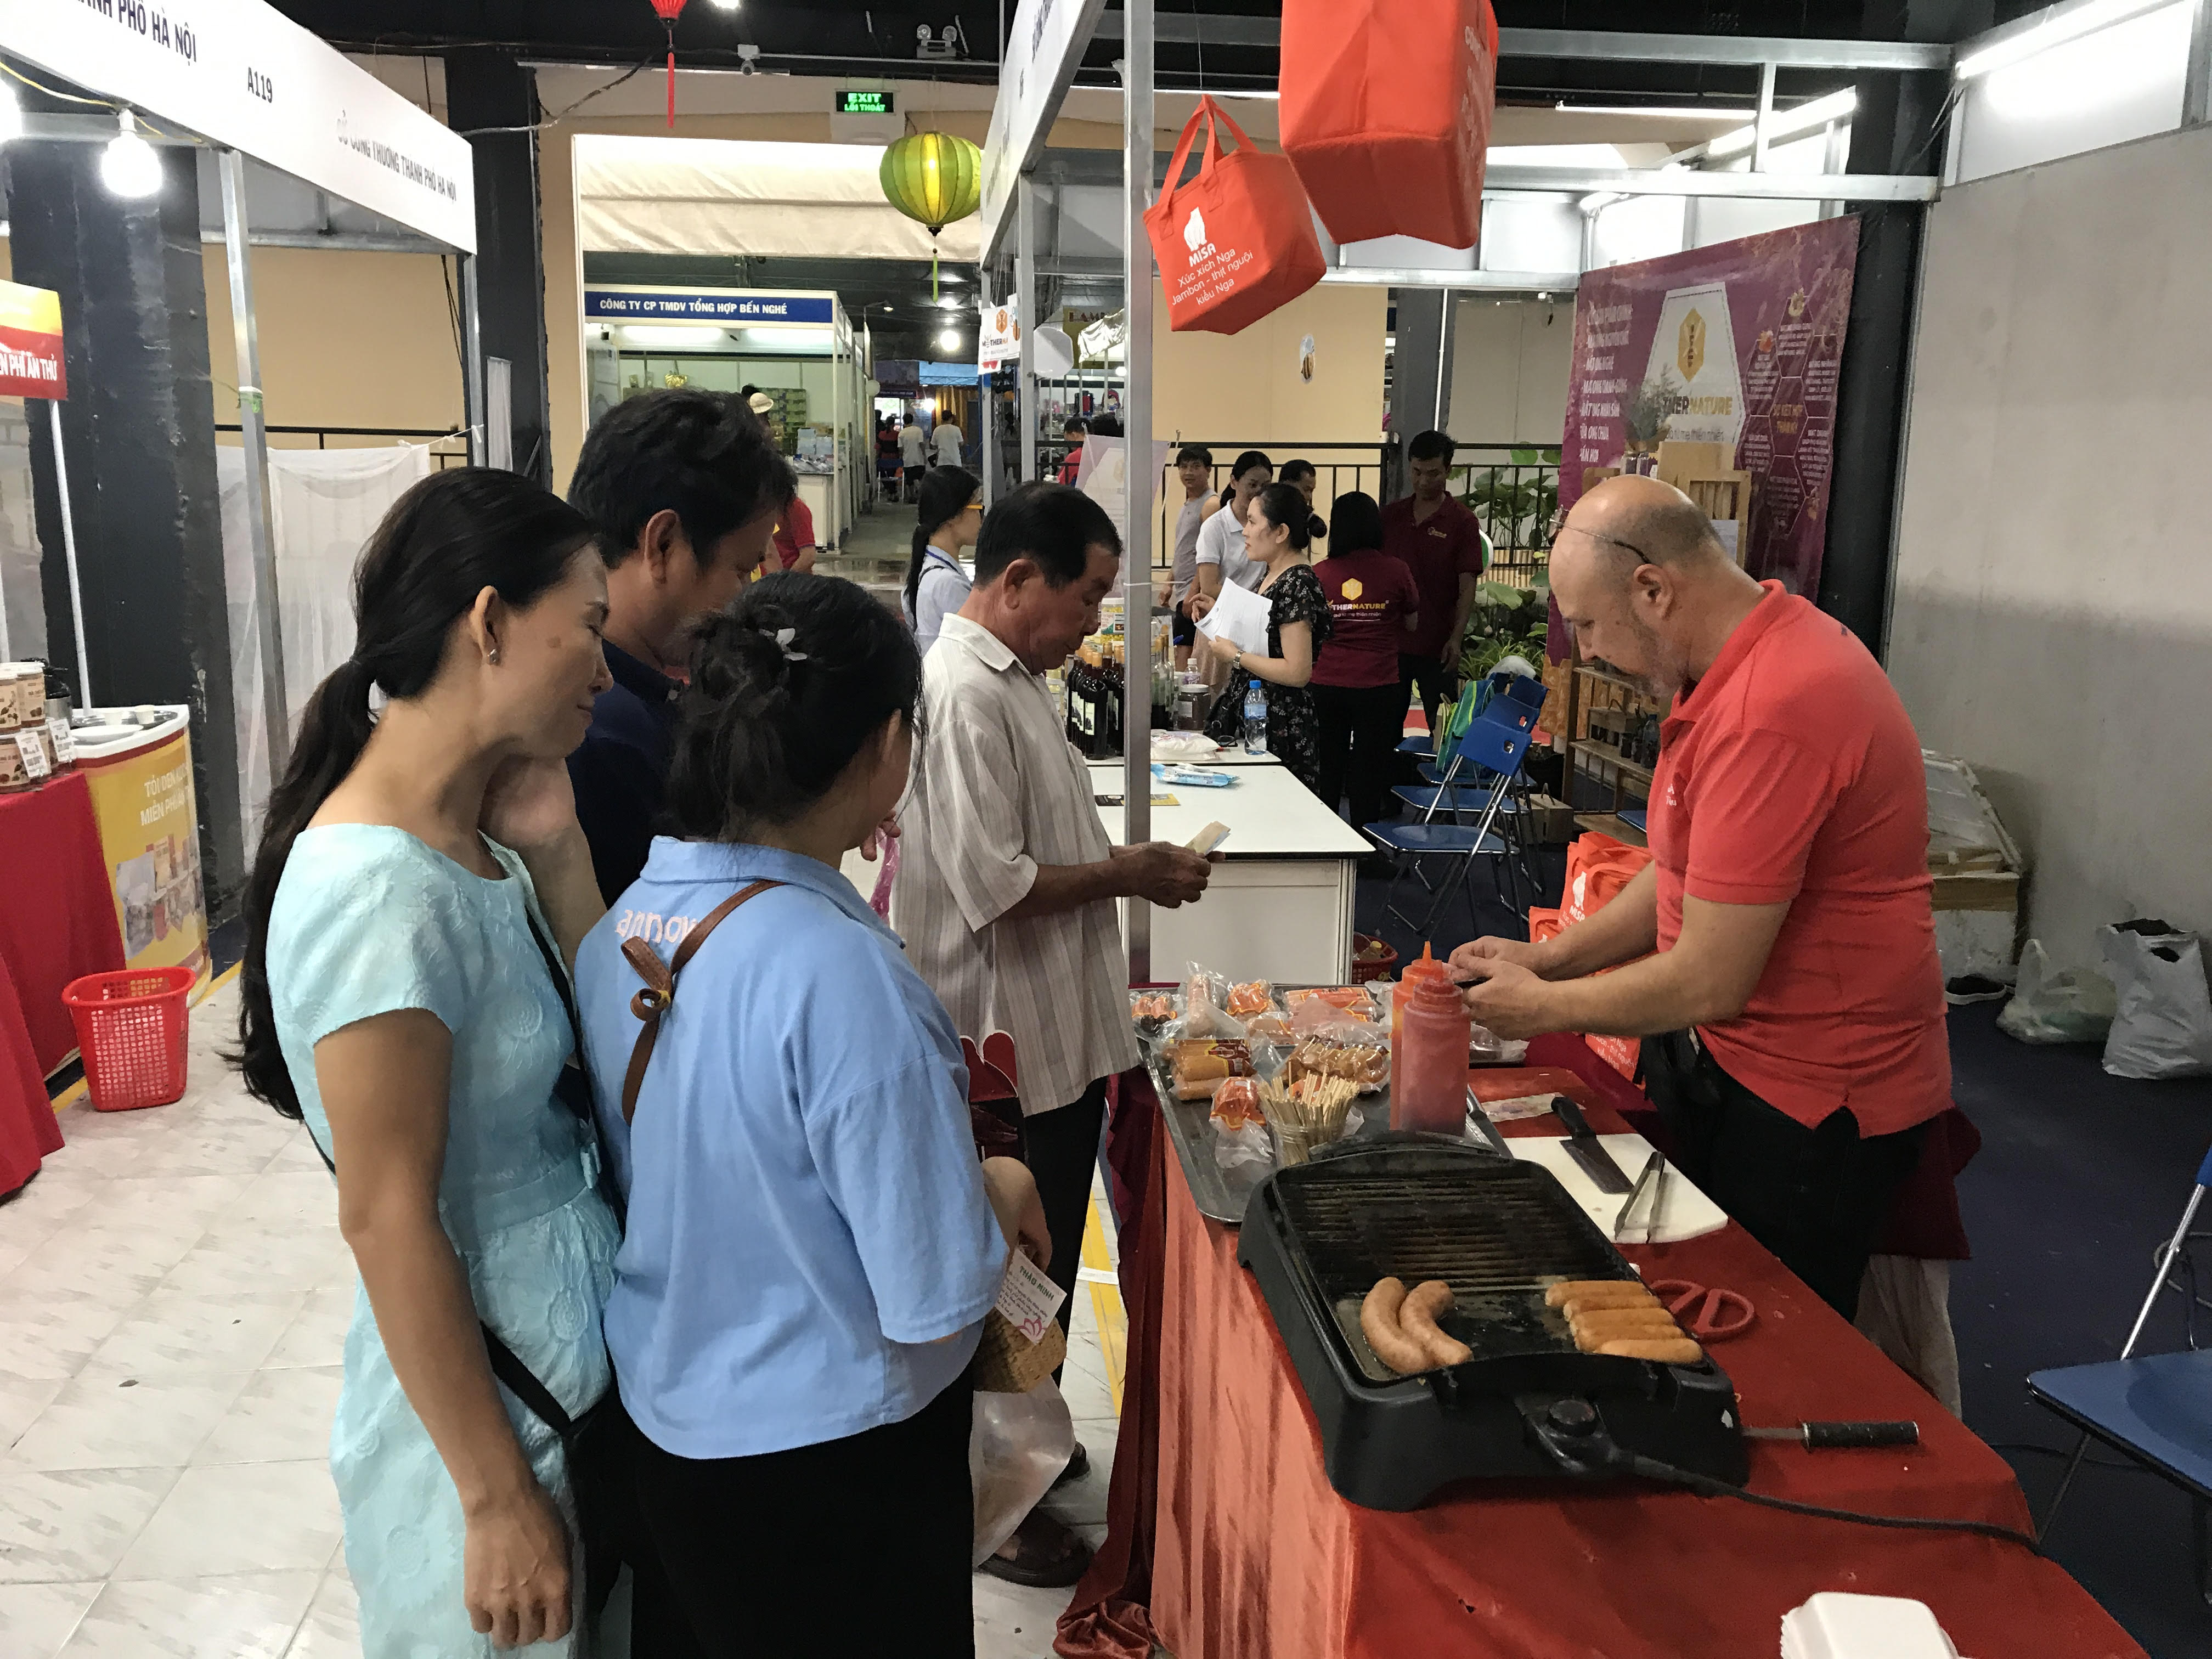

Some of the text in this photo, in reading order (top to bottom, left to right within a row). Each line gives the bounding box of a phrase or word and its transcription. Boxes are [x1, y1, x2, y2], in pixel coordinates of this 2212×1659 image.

[151, 7, 170, 48] HÀ
[174, 22, 196, 66] NỘI
[247, 67, 273, 103] A119
[848, 93, 882, 103] EXIT
[1189, 243, 1216, 267] MISA
[1172, 280, 1205, 306] Jambon
[1211, 267, 1226, 281] thịt
[1227, 250, 1254, 272] nguội
[1177, 249, 1235, 288] Xúc xích Nga
[1215, 278, 1234, 294] Nga
[600, 298, 788, 315] CÔNG TY CP TMDV TỔNG HỢP BẾN NGHÉ
[1036, 1283, 1054, 1301] MINH
